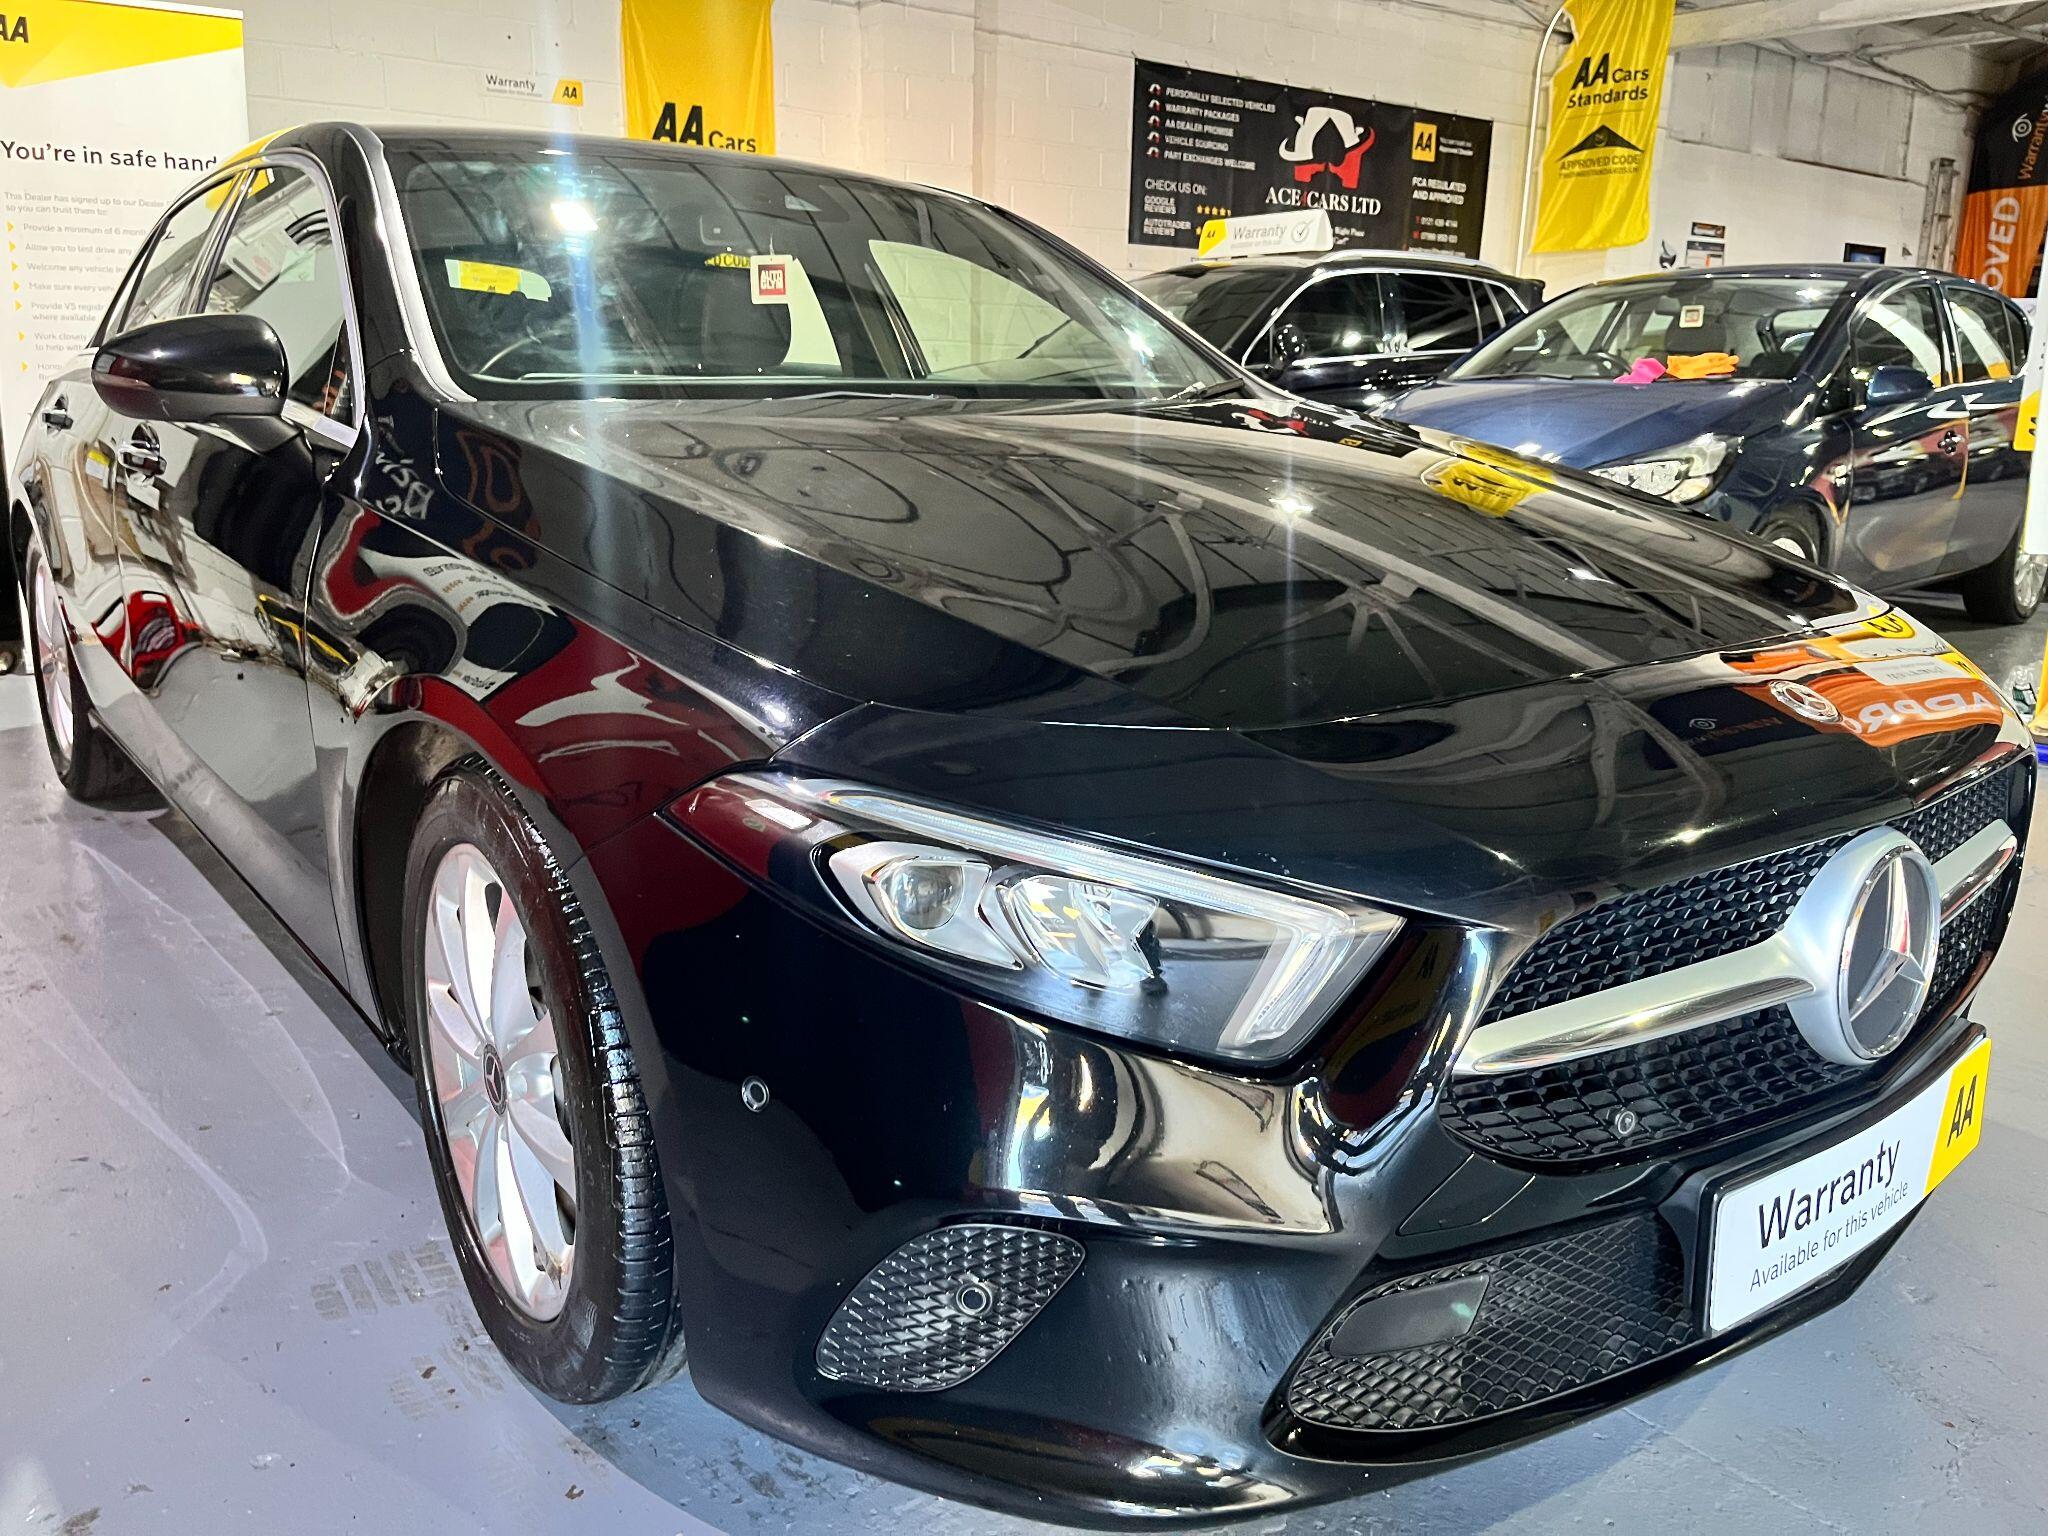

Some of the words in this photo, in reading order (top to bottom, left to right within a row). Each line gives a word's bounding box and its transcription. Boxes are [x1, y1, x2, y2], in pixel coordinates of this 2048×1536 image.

[485, 73, 536, 92] Warranty
[1571, 52, 1610, 91] AA
[1612, 68, 1649, 83] Cars
[562, 86, 578, 99] AA
[1567, 86, 1648, 109] Standards
[652, 101, 704, 146] AA
[708, 130, 757, 153] Cars
[1415, 131, 1432, 152] AA
[83, 145, 103, 164] in
[110, 150, 157, 168] safe
[1145, 179, 1177, 192] CHECK
[1178, 183, 1191, 194] US
[1191, 184, 1208, 196] ON:
[1351, 196, 1381, 215] LTD
[1233, 224, 1287, 240] Warranty
[1947, 1073, 1978, 1148] AA
[1758, 1139, 1901, 1249] Warranty
[1750, 1240, 1819, 1293] Available
[1823, 1228, 1843, 1252] for
[1845, 1210, 1868, 1238] this
[1871, 1181, 1909, 1221] vehicle
